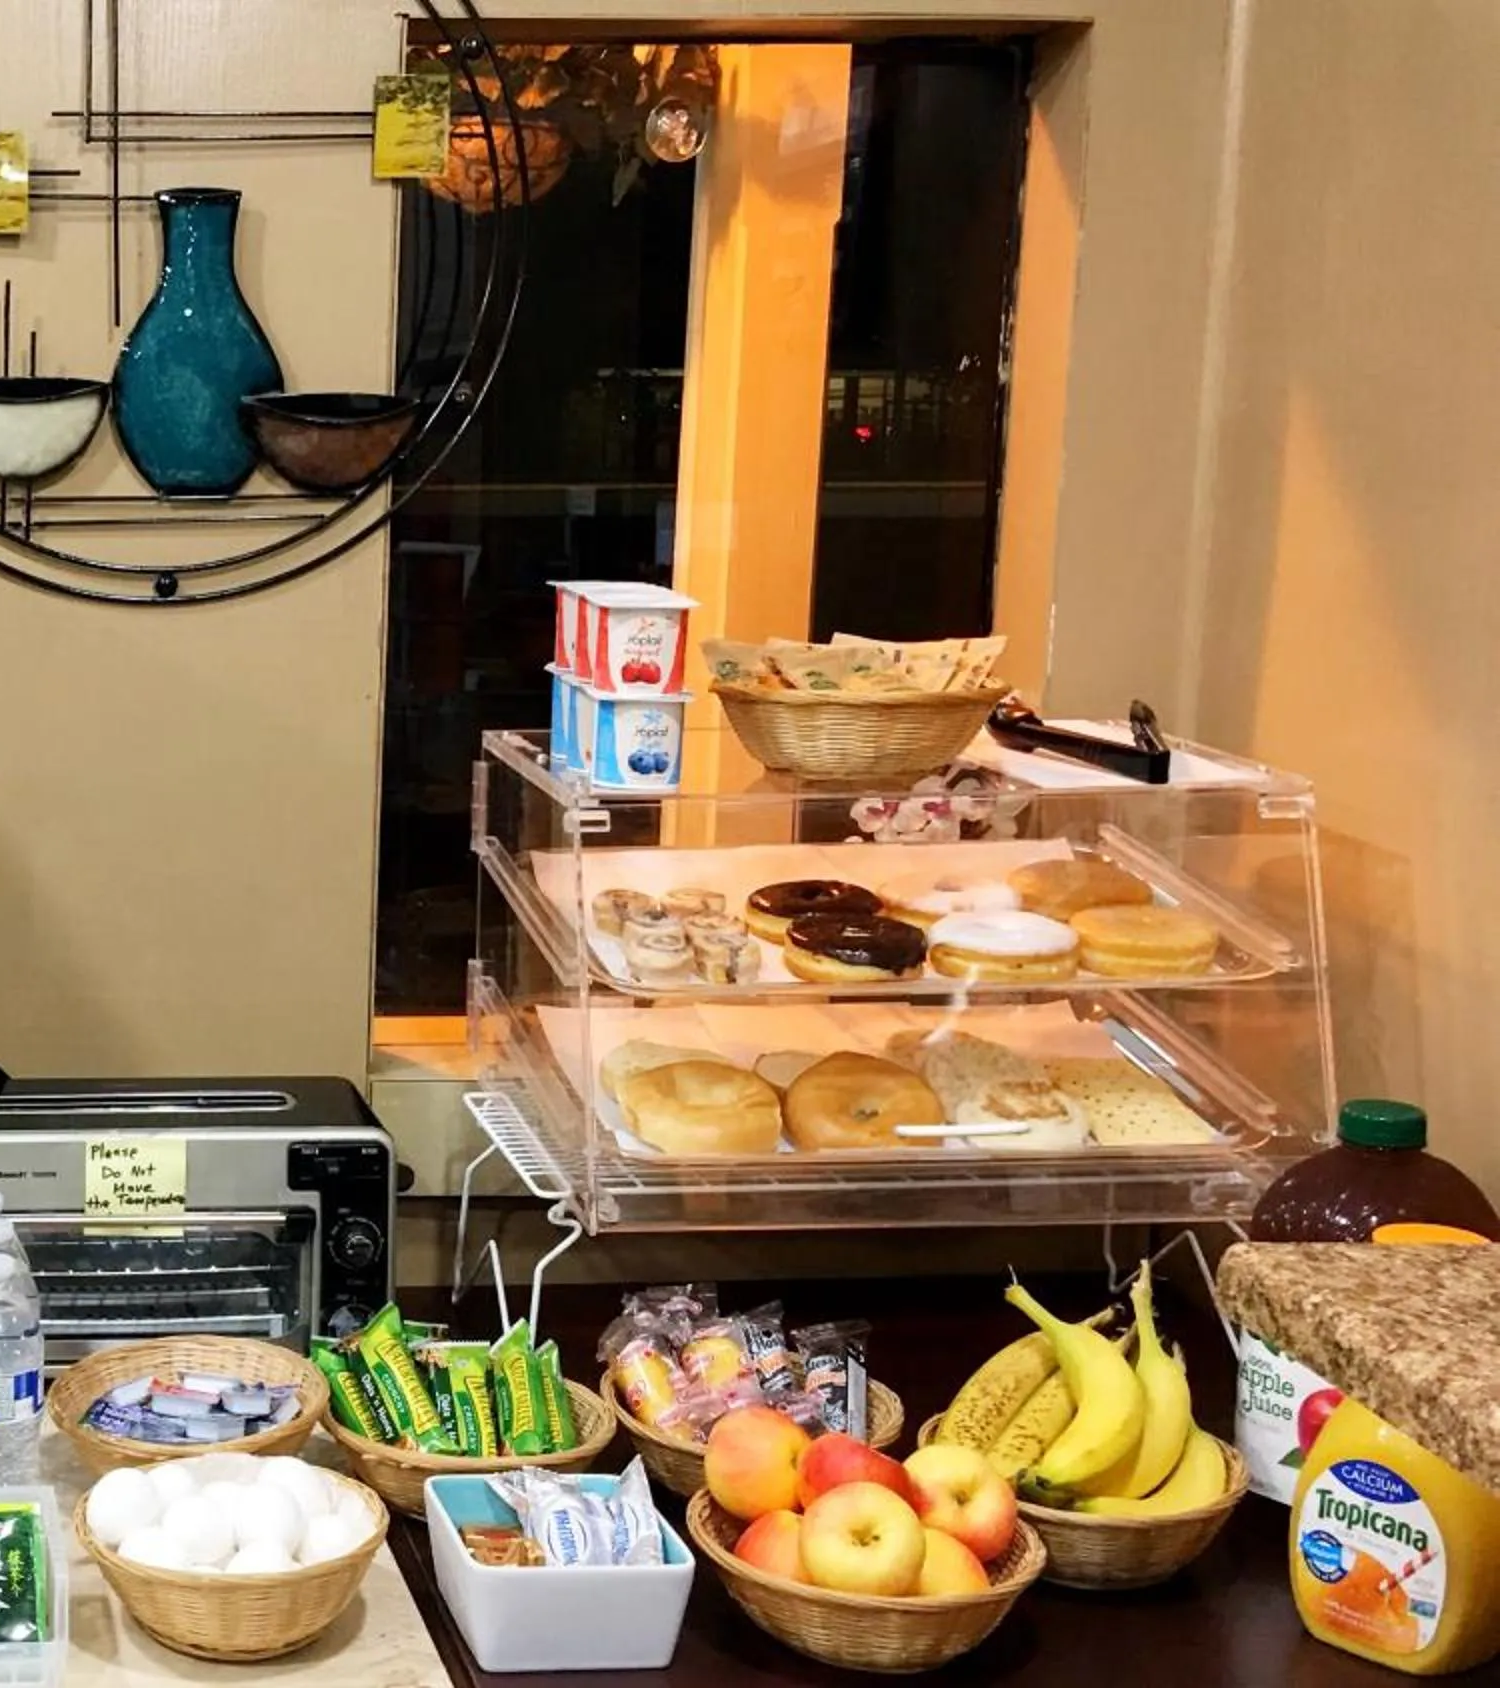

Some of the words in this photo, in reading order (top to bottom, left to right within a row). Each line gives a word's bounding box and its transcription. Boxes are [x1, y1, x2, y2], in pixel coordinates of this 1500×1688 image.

[91, 1142, 138, 1160] Please
[101, 1165, 121, 1180] Do
[131, 1163, 157, 1178] Not
[1240, 1361, 1295, 1398] Apple
[1241, 1389, 1294, 1420] Juice
[1341, 1466, 1403, 1496] CALCIUM
[1316, 1488, 1429, 1551] Tropicana
